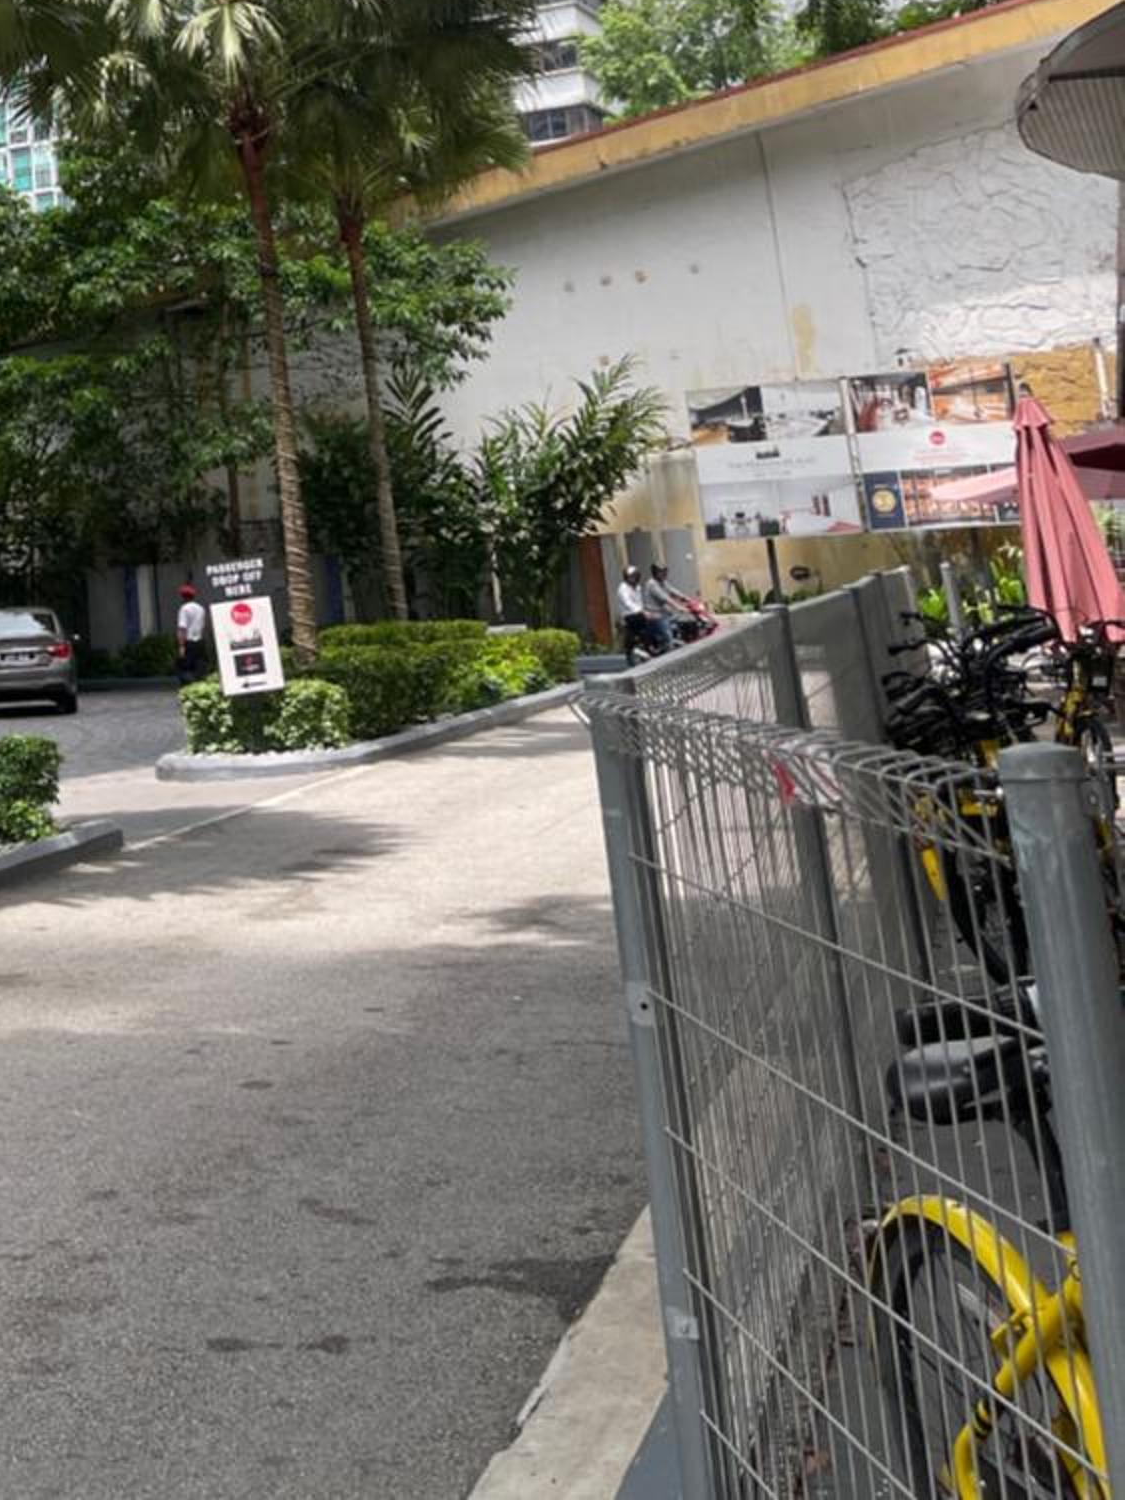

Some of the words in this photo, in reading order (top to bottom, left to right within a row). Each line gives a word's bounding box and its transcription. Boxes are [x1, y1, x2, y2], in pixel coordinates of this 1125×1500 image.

[206, 558, 264, 575] PASSENGER
[212, 573, 239, 588] DROP
[242, 569, 262, 582] OFF
[225, 583, 252, 597] HERE
